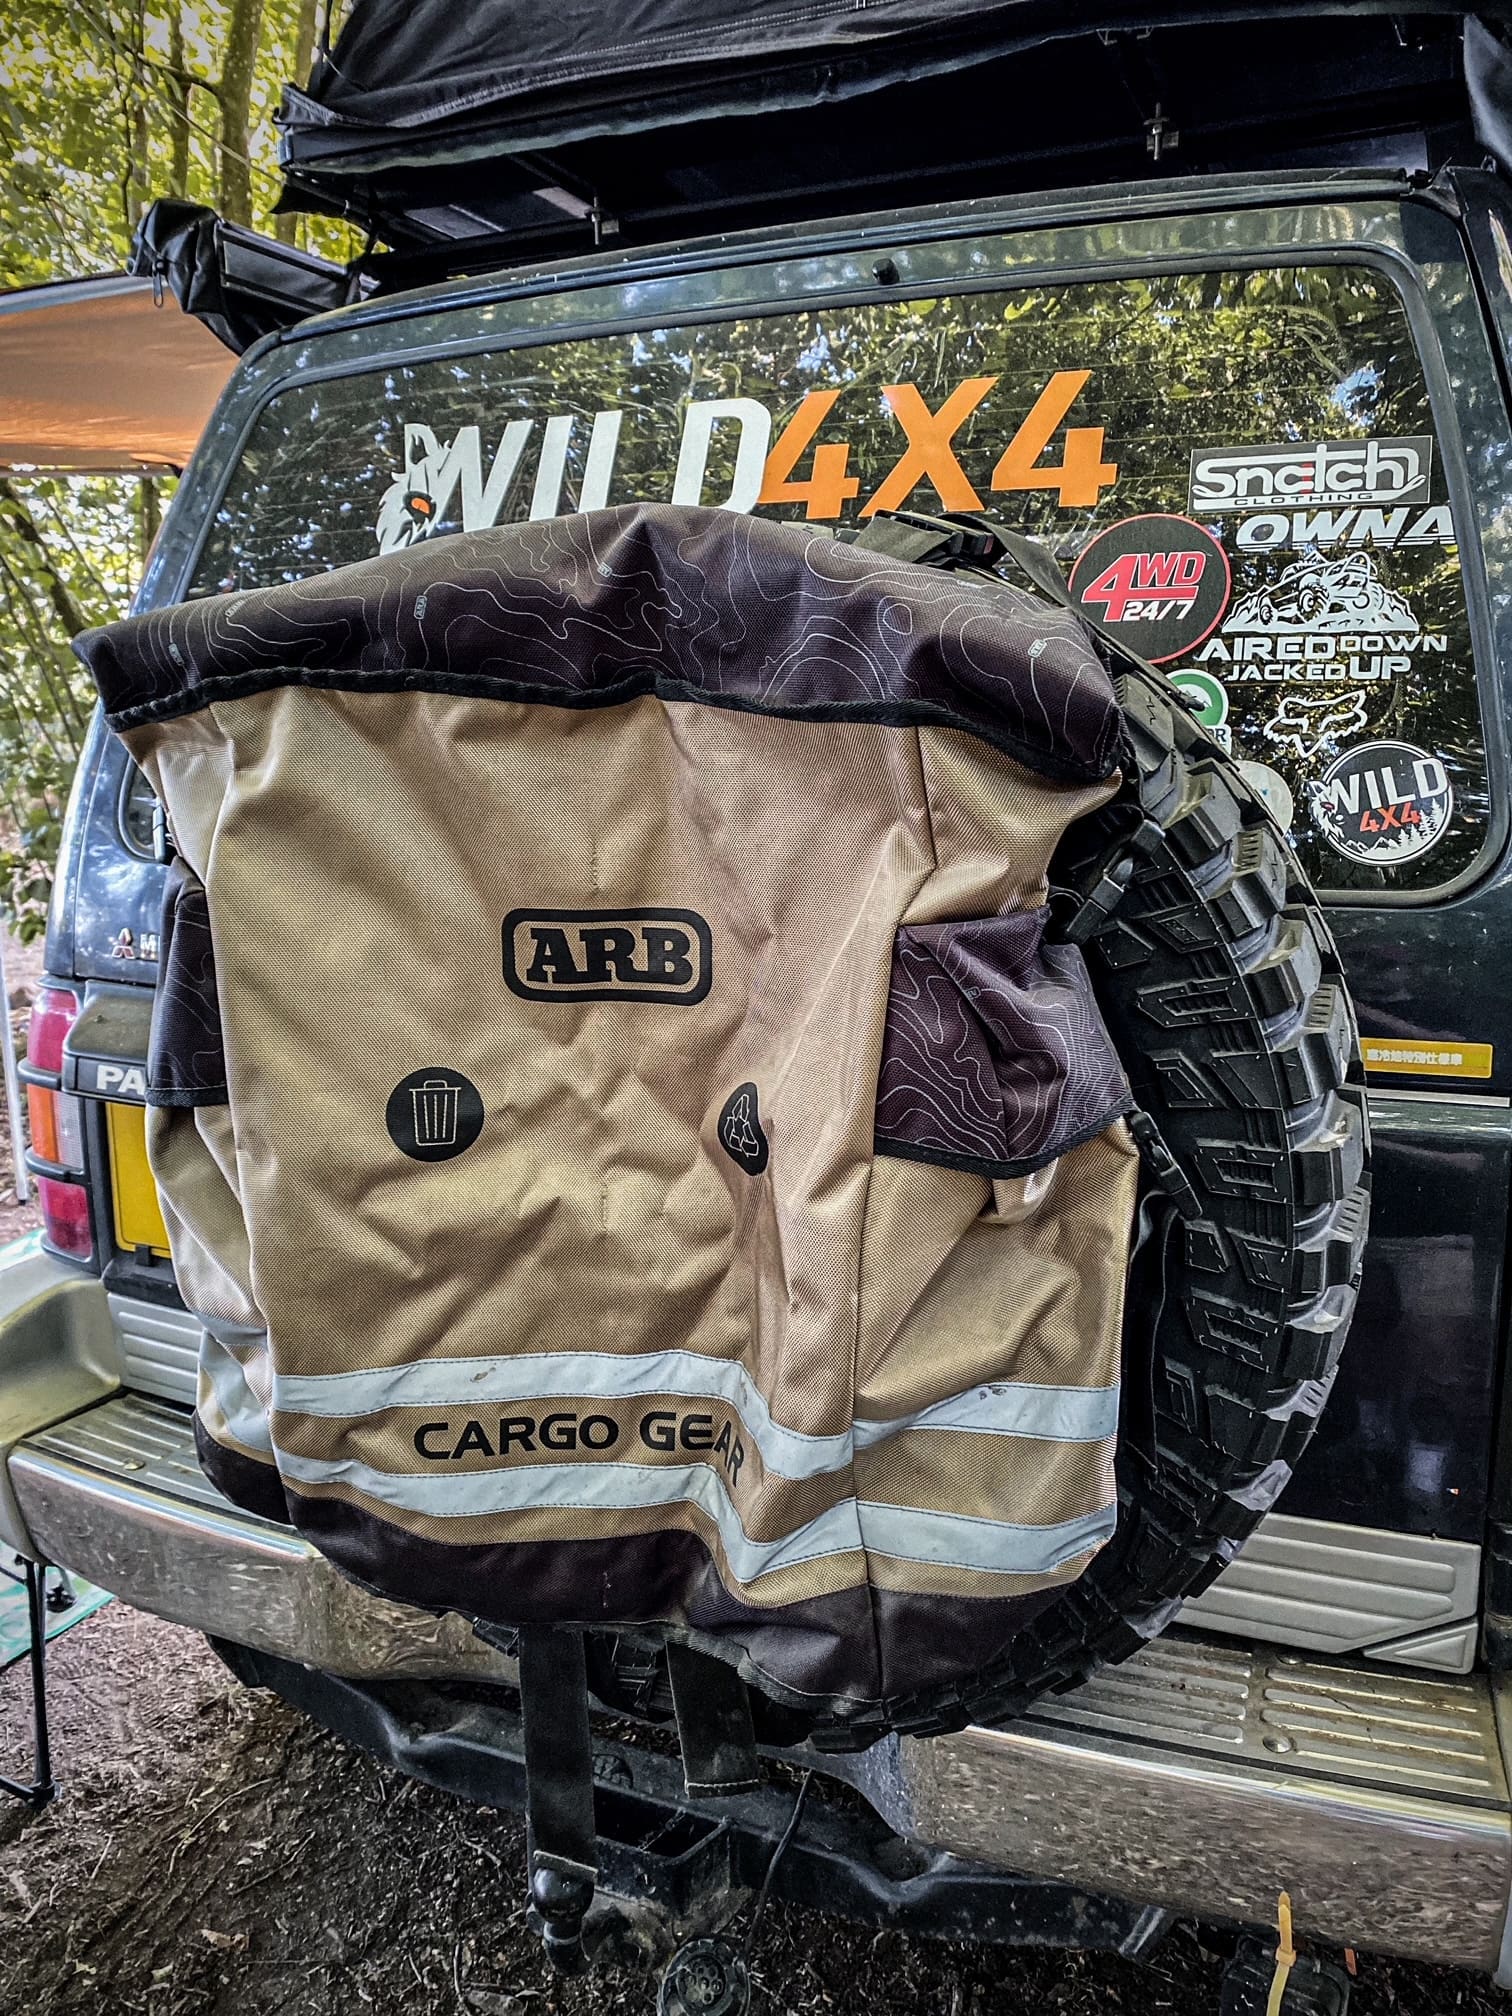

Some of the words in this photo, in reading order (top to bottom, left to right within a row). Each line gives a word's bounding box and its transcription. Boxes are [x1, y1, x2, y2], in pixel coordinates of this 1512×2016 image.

[1234, 493, 1374, 506] CLOTHING
[1081, 551, 1206, 622] 4WD
[1123, 600, 1195, 621] 24/7
[1198, 636, 1337, 661] AIRED
[1339, 635, 1448, 652] DOWN
[1225, 664, 1346, 681] JACKED
[1351, 656, 1411, 680] UP
[1325, 757, 1448, 814] WILD
[1360, 802, 1422, 833] 4X4
[526, 927, 693, 985] ARB
[414, 1412, 620, 1460] CARGO
[639, 1410, 745, 1488] GEAR
